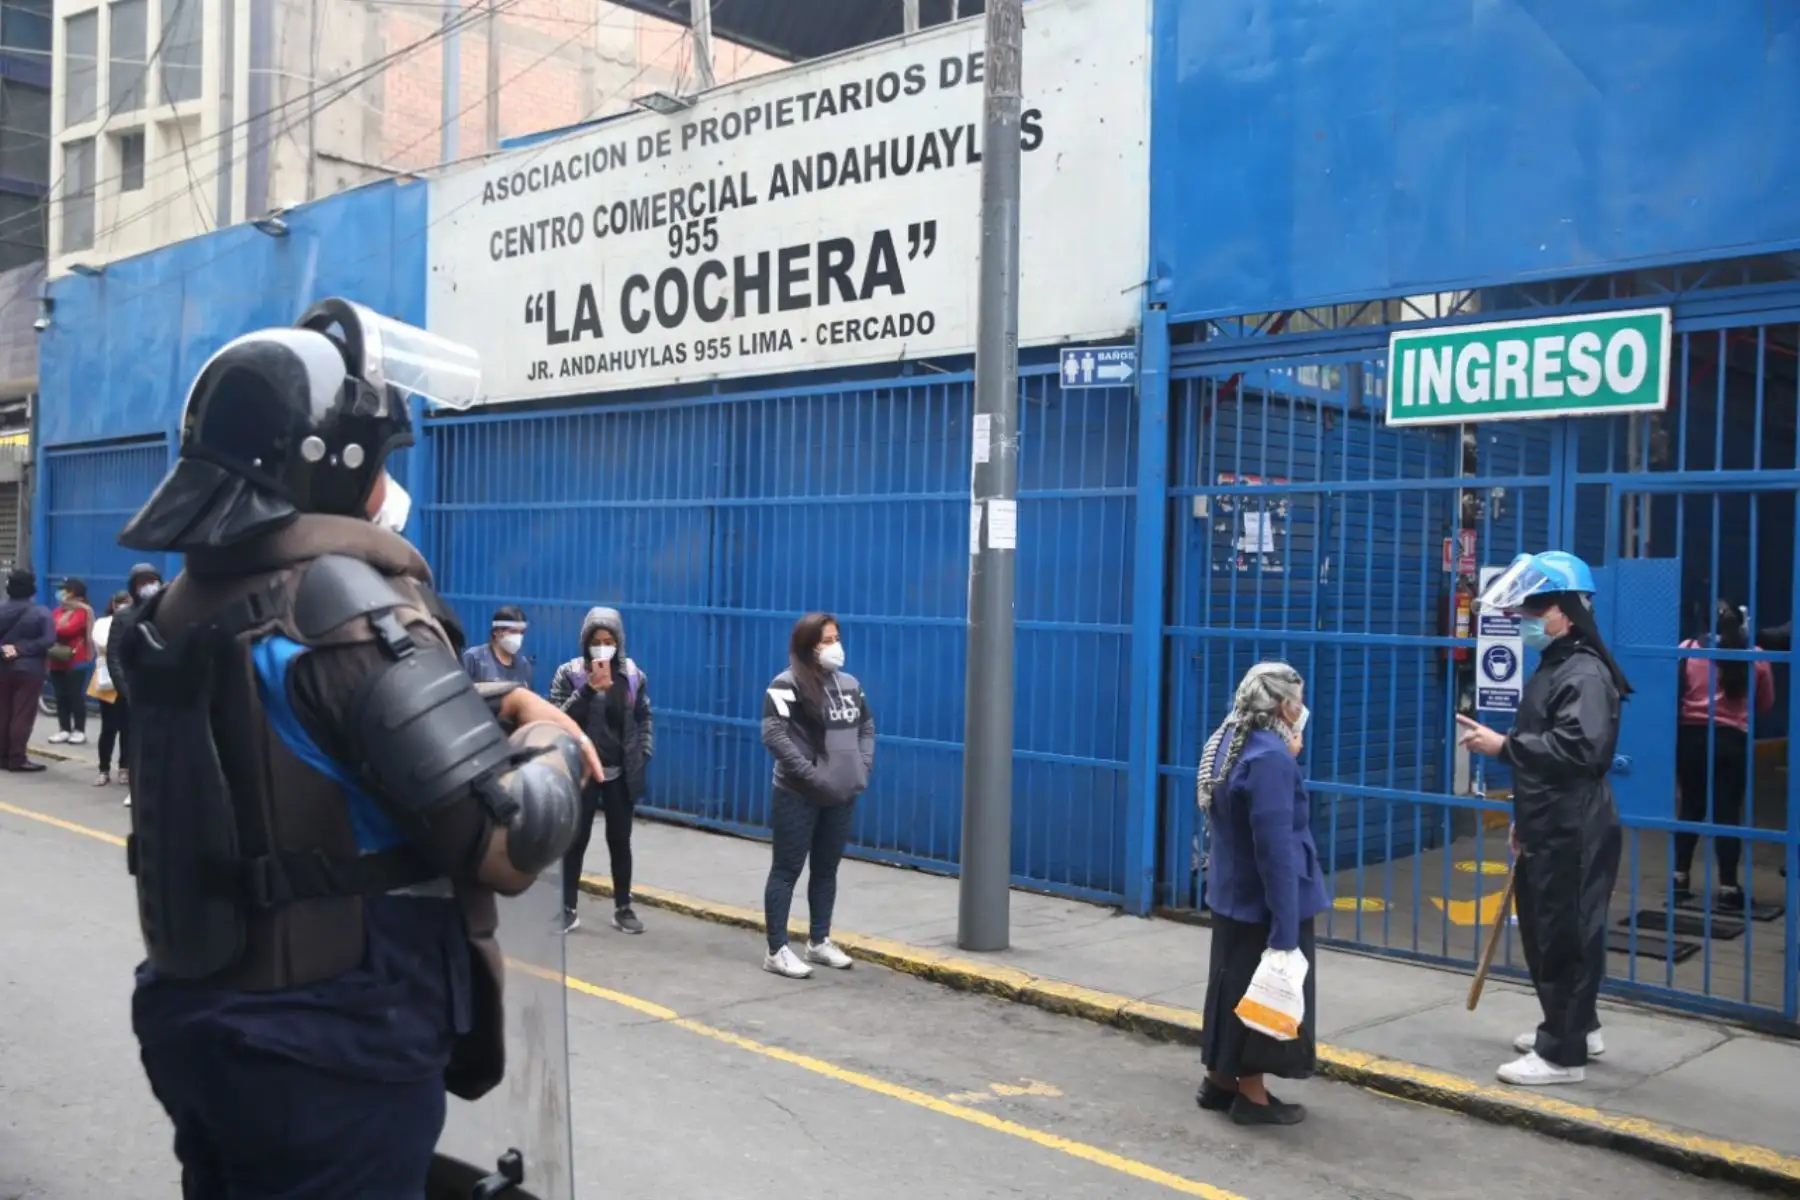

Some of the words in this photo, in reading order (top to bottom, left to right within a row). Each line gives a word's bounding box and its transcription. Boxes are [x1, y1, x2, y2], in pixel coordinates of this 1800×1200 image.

[482, 141, 627, 205] ASOCIACION
[637, 130, 672, 162] DE
[682, 64, 926, 151] PROPIETARIOS
[939, 52, 984, 89] DE
[490, 212, 584, 261] CENTRO
[593, 171, 757, 238] COMERCIAL
[768, 108, 1044, 201] ANDAHUAYLS
[668, 217, 719, 259] 955
[527, 360, 554, 381] JR.
[559, 342, 687, 377] ANDAHUYLAS
[694, 336, 731, 362] 955
[738, 329, 793, 356] LIMA
[816, 310, 935, 345] CERCADO
[1401, 328, 1647, 406] INGRESO
